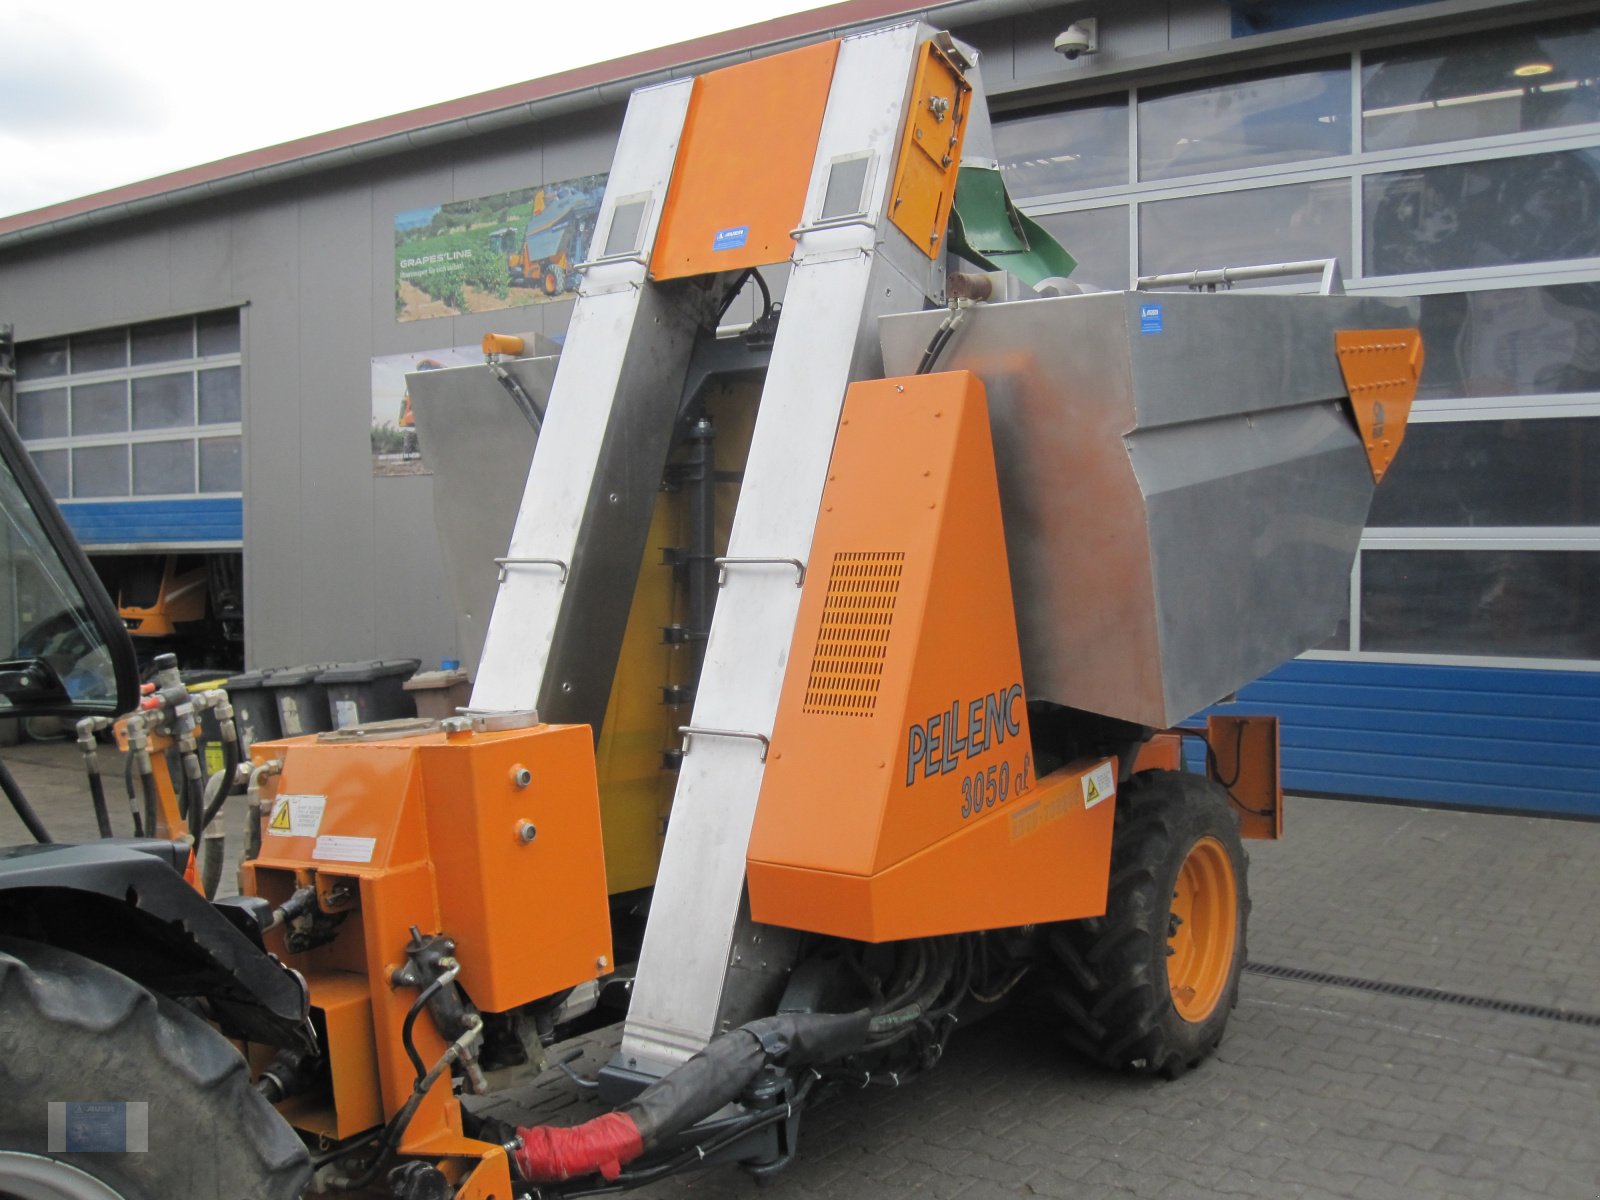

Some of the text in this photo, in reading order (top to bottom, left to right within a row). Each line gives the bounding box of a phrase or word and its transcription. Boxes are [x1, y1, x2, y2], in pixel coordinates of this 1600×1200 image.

[400, 249, 472, 268] GRAPES'LINE
[906, 683, 1022, 787] PELLENC
[962, 761, 1010, 818] 3050
